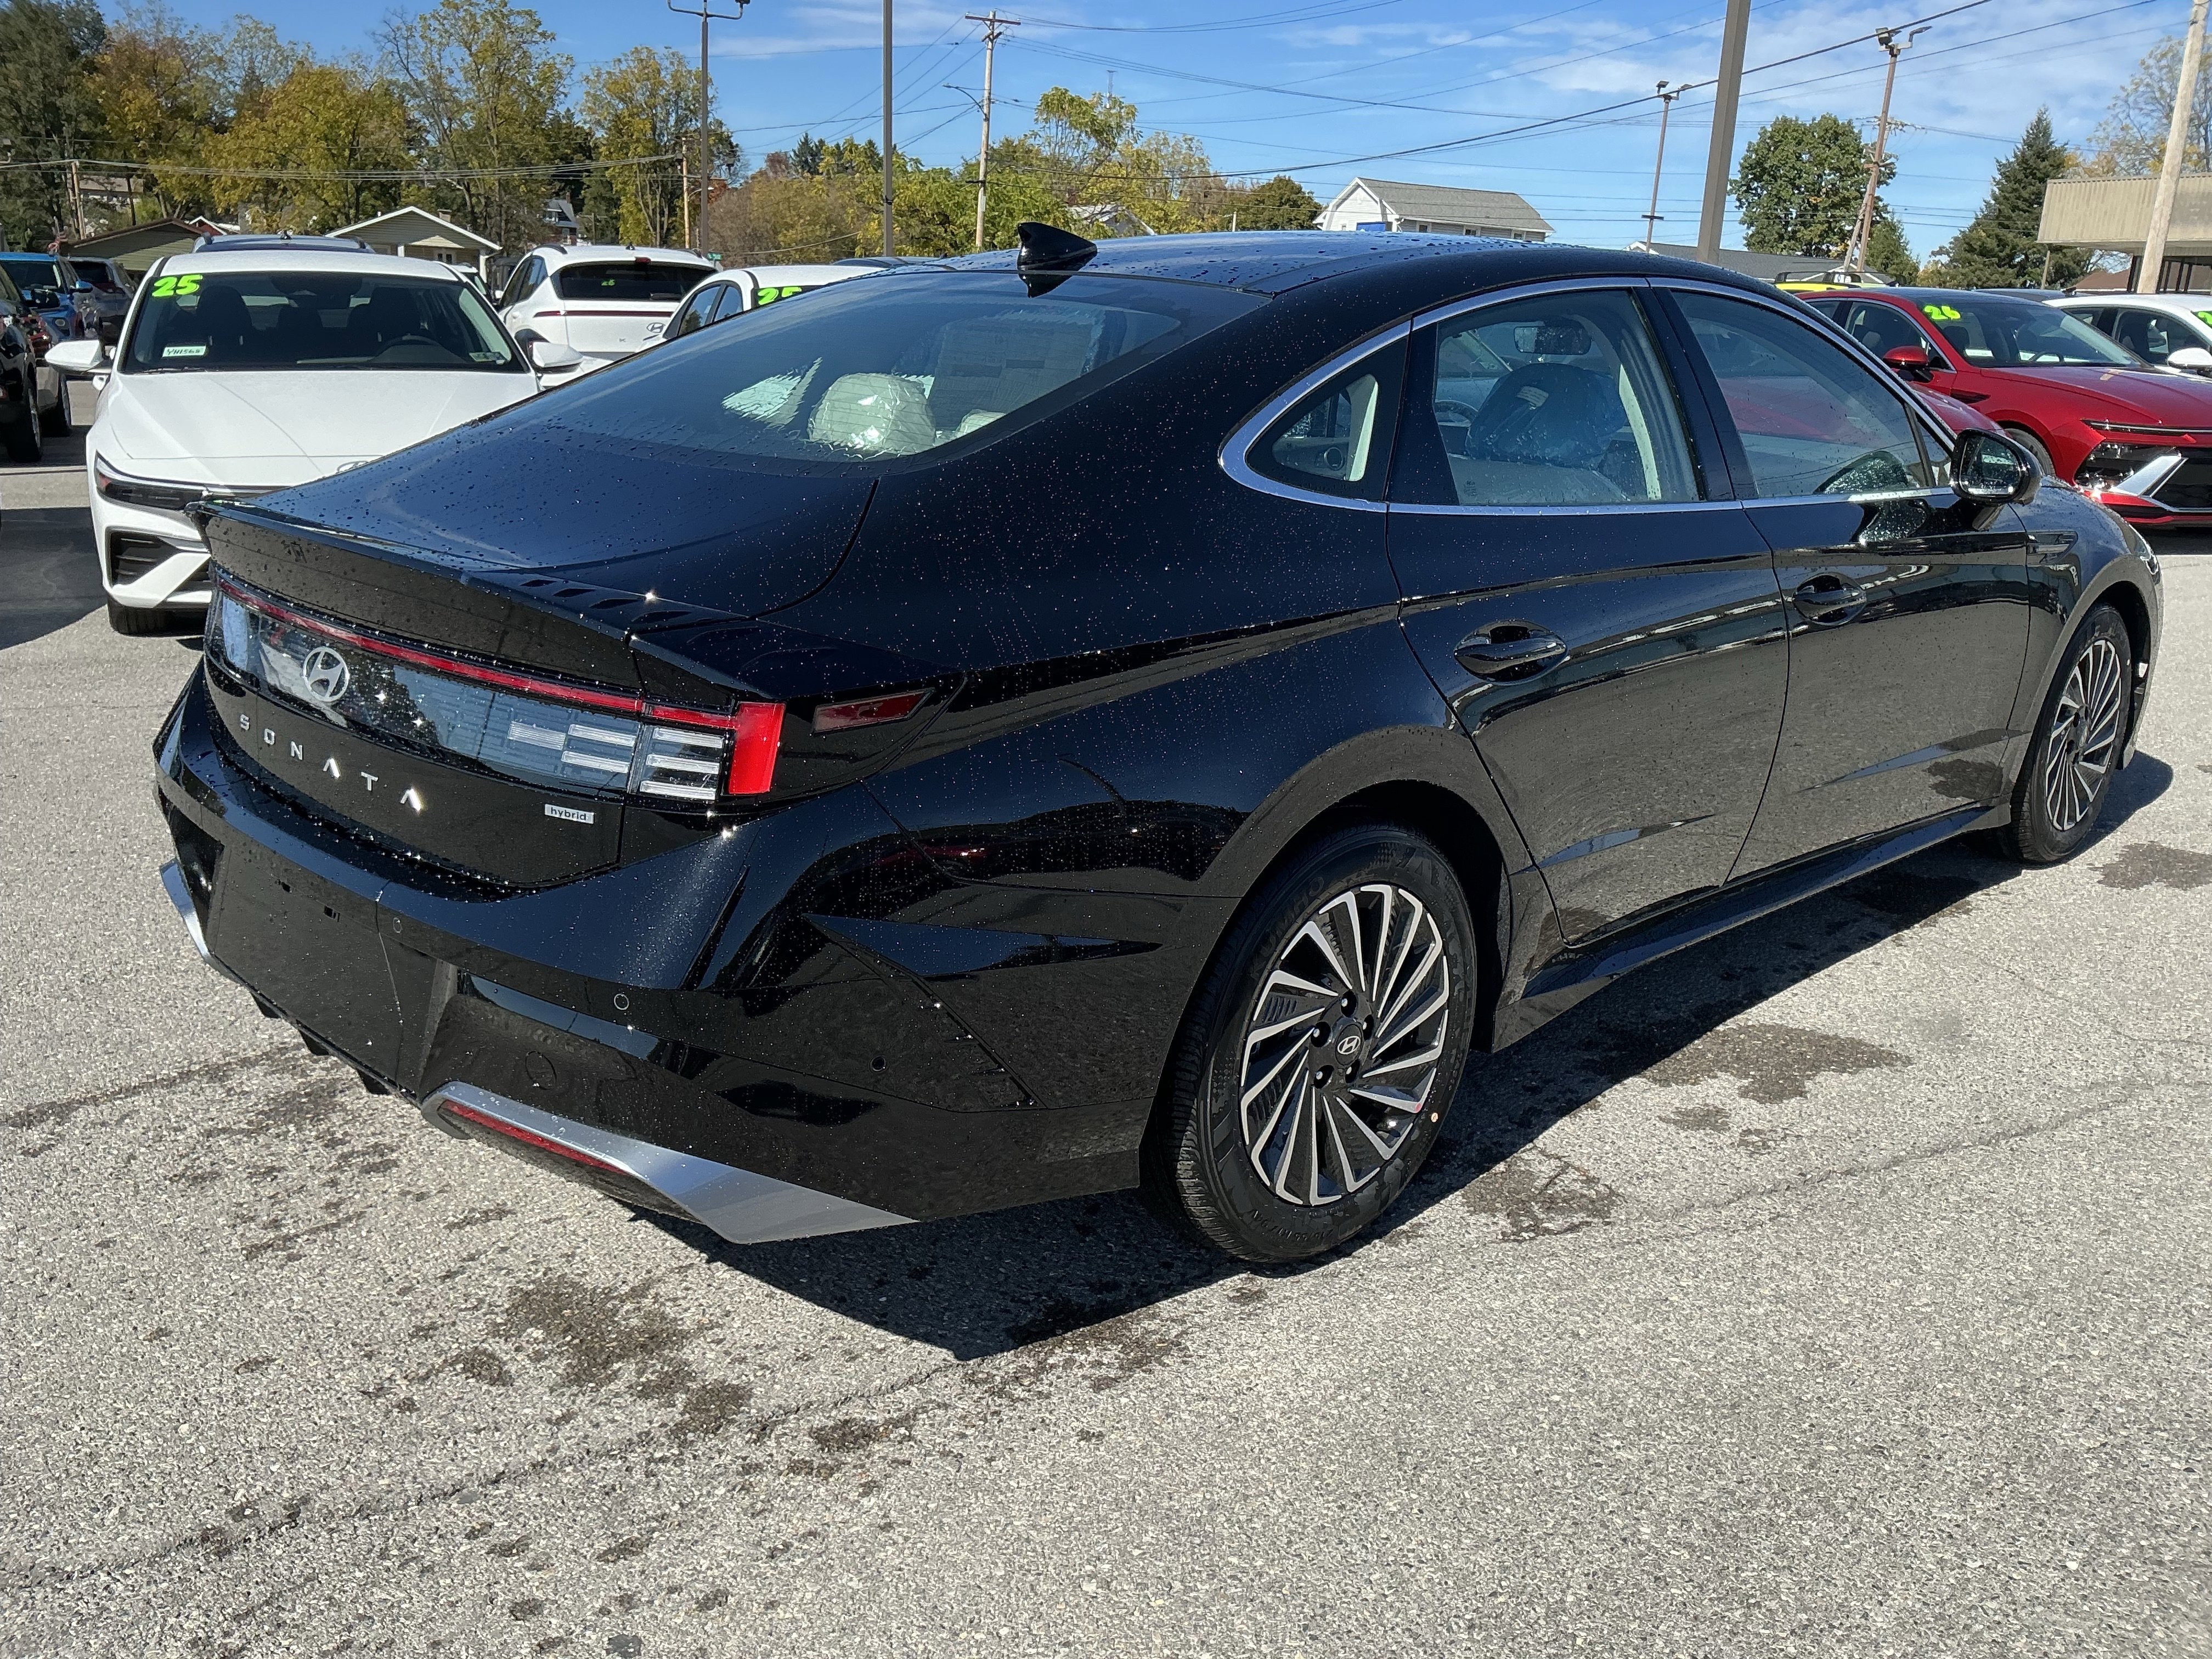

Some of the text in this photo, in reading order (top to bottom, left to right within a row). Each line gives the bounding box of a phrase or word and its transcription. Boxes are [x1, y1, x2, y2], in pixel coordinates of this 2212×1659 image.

[152, 274, 202, 296] 25
[1925, 306, 1961, 320] 26
[239, 714, 424, 812] SONATA
[550, 806, 587, 822] hybrid
